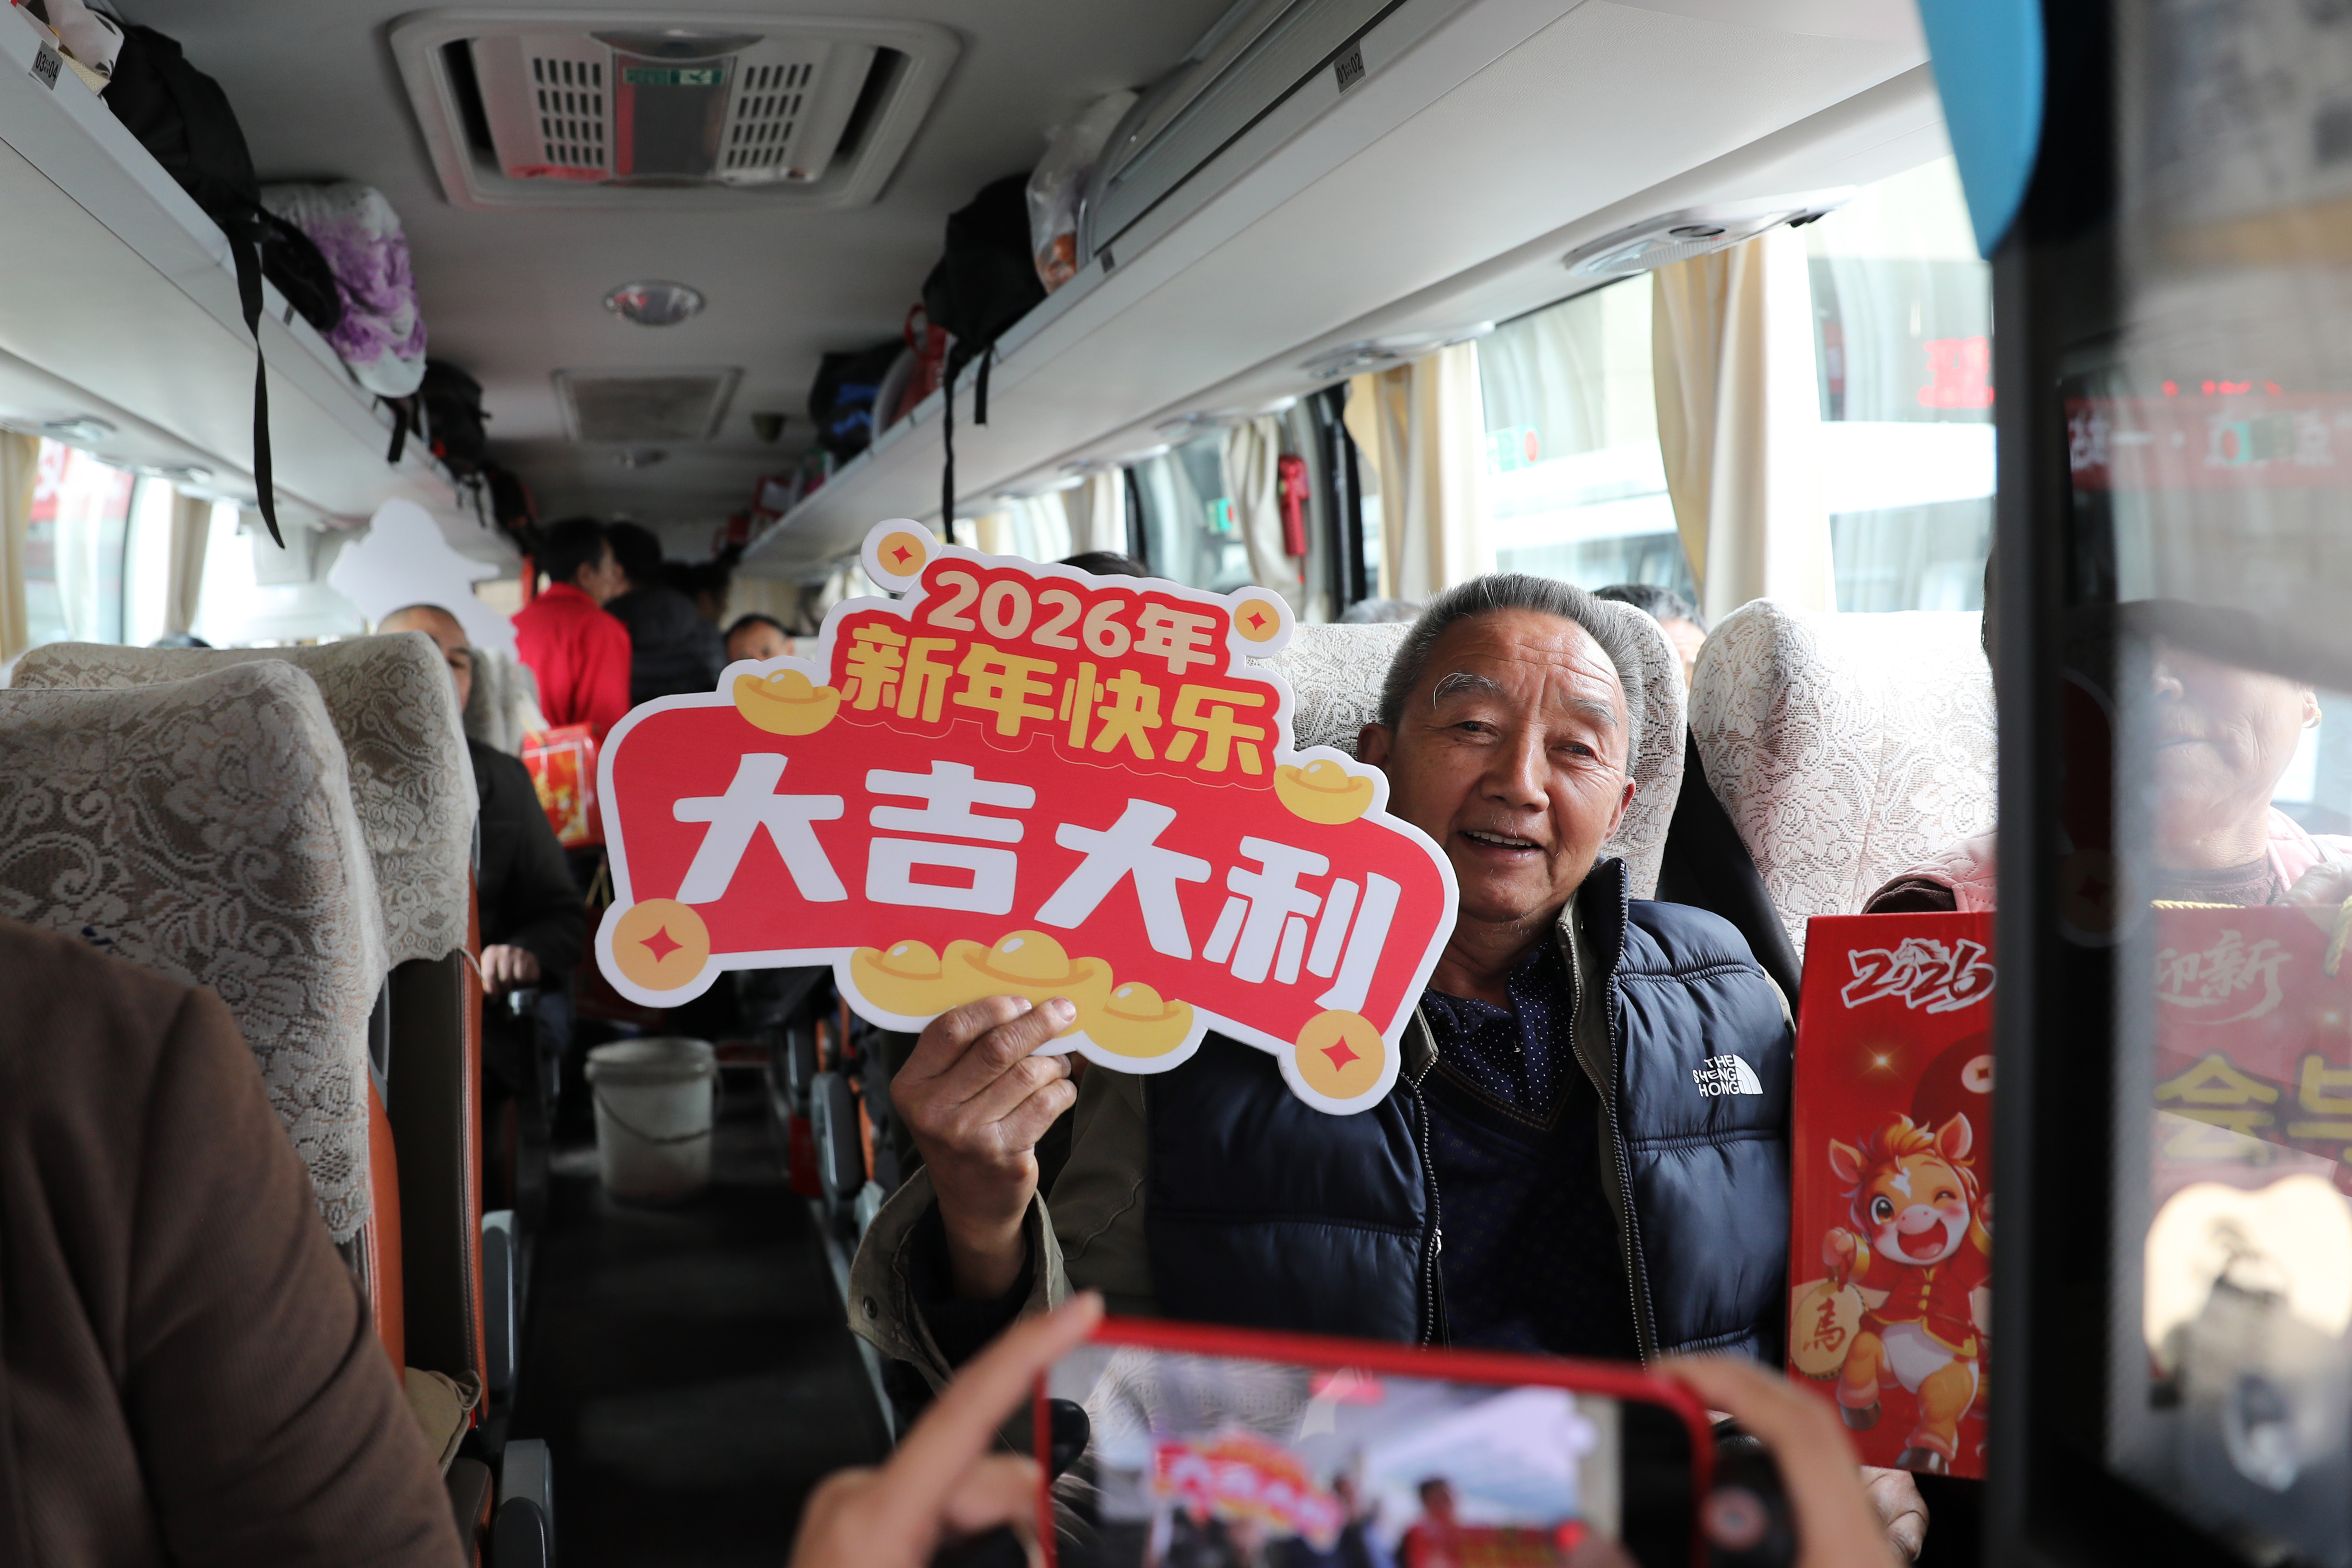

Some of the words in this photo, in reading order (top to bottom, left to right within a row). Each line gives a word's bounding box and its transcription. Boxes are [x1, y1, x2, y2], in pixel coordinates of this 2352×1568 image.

[35, 51, 47, 72] 03
[48, 60, 59, 81] 04
[1350, 52, 1363, 74] 02
[1337, 63, 1348, 84] 01
[927, 570, 1217, 675] 2026年
[840, 622, 1266, 775] 新年快乐
[672, 752, 1402, 1013] 大吉大利
[1841, 937, 1997, 1014] 2026
[1704, 1055, 1736, 1068] THE
[1692, 1067, 1737, 1084] SHENG
[1698, 1081, 1740, 1097] HONG
